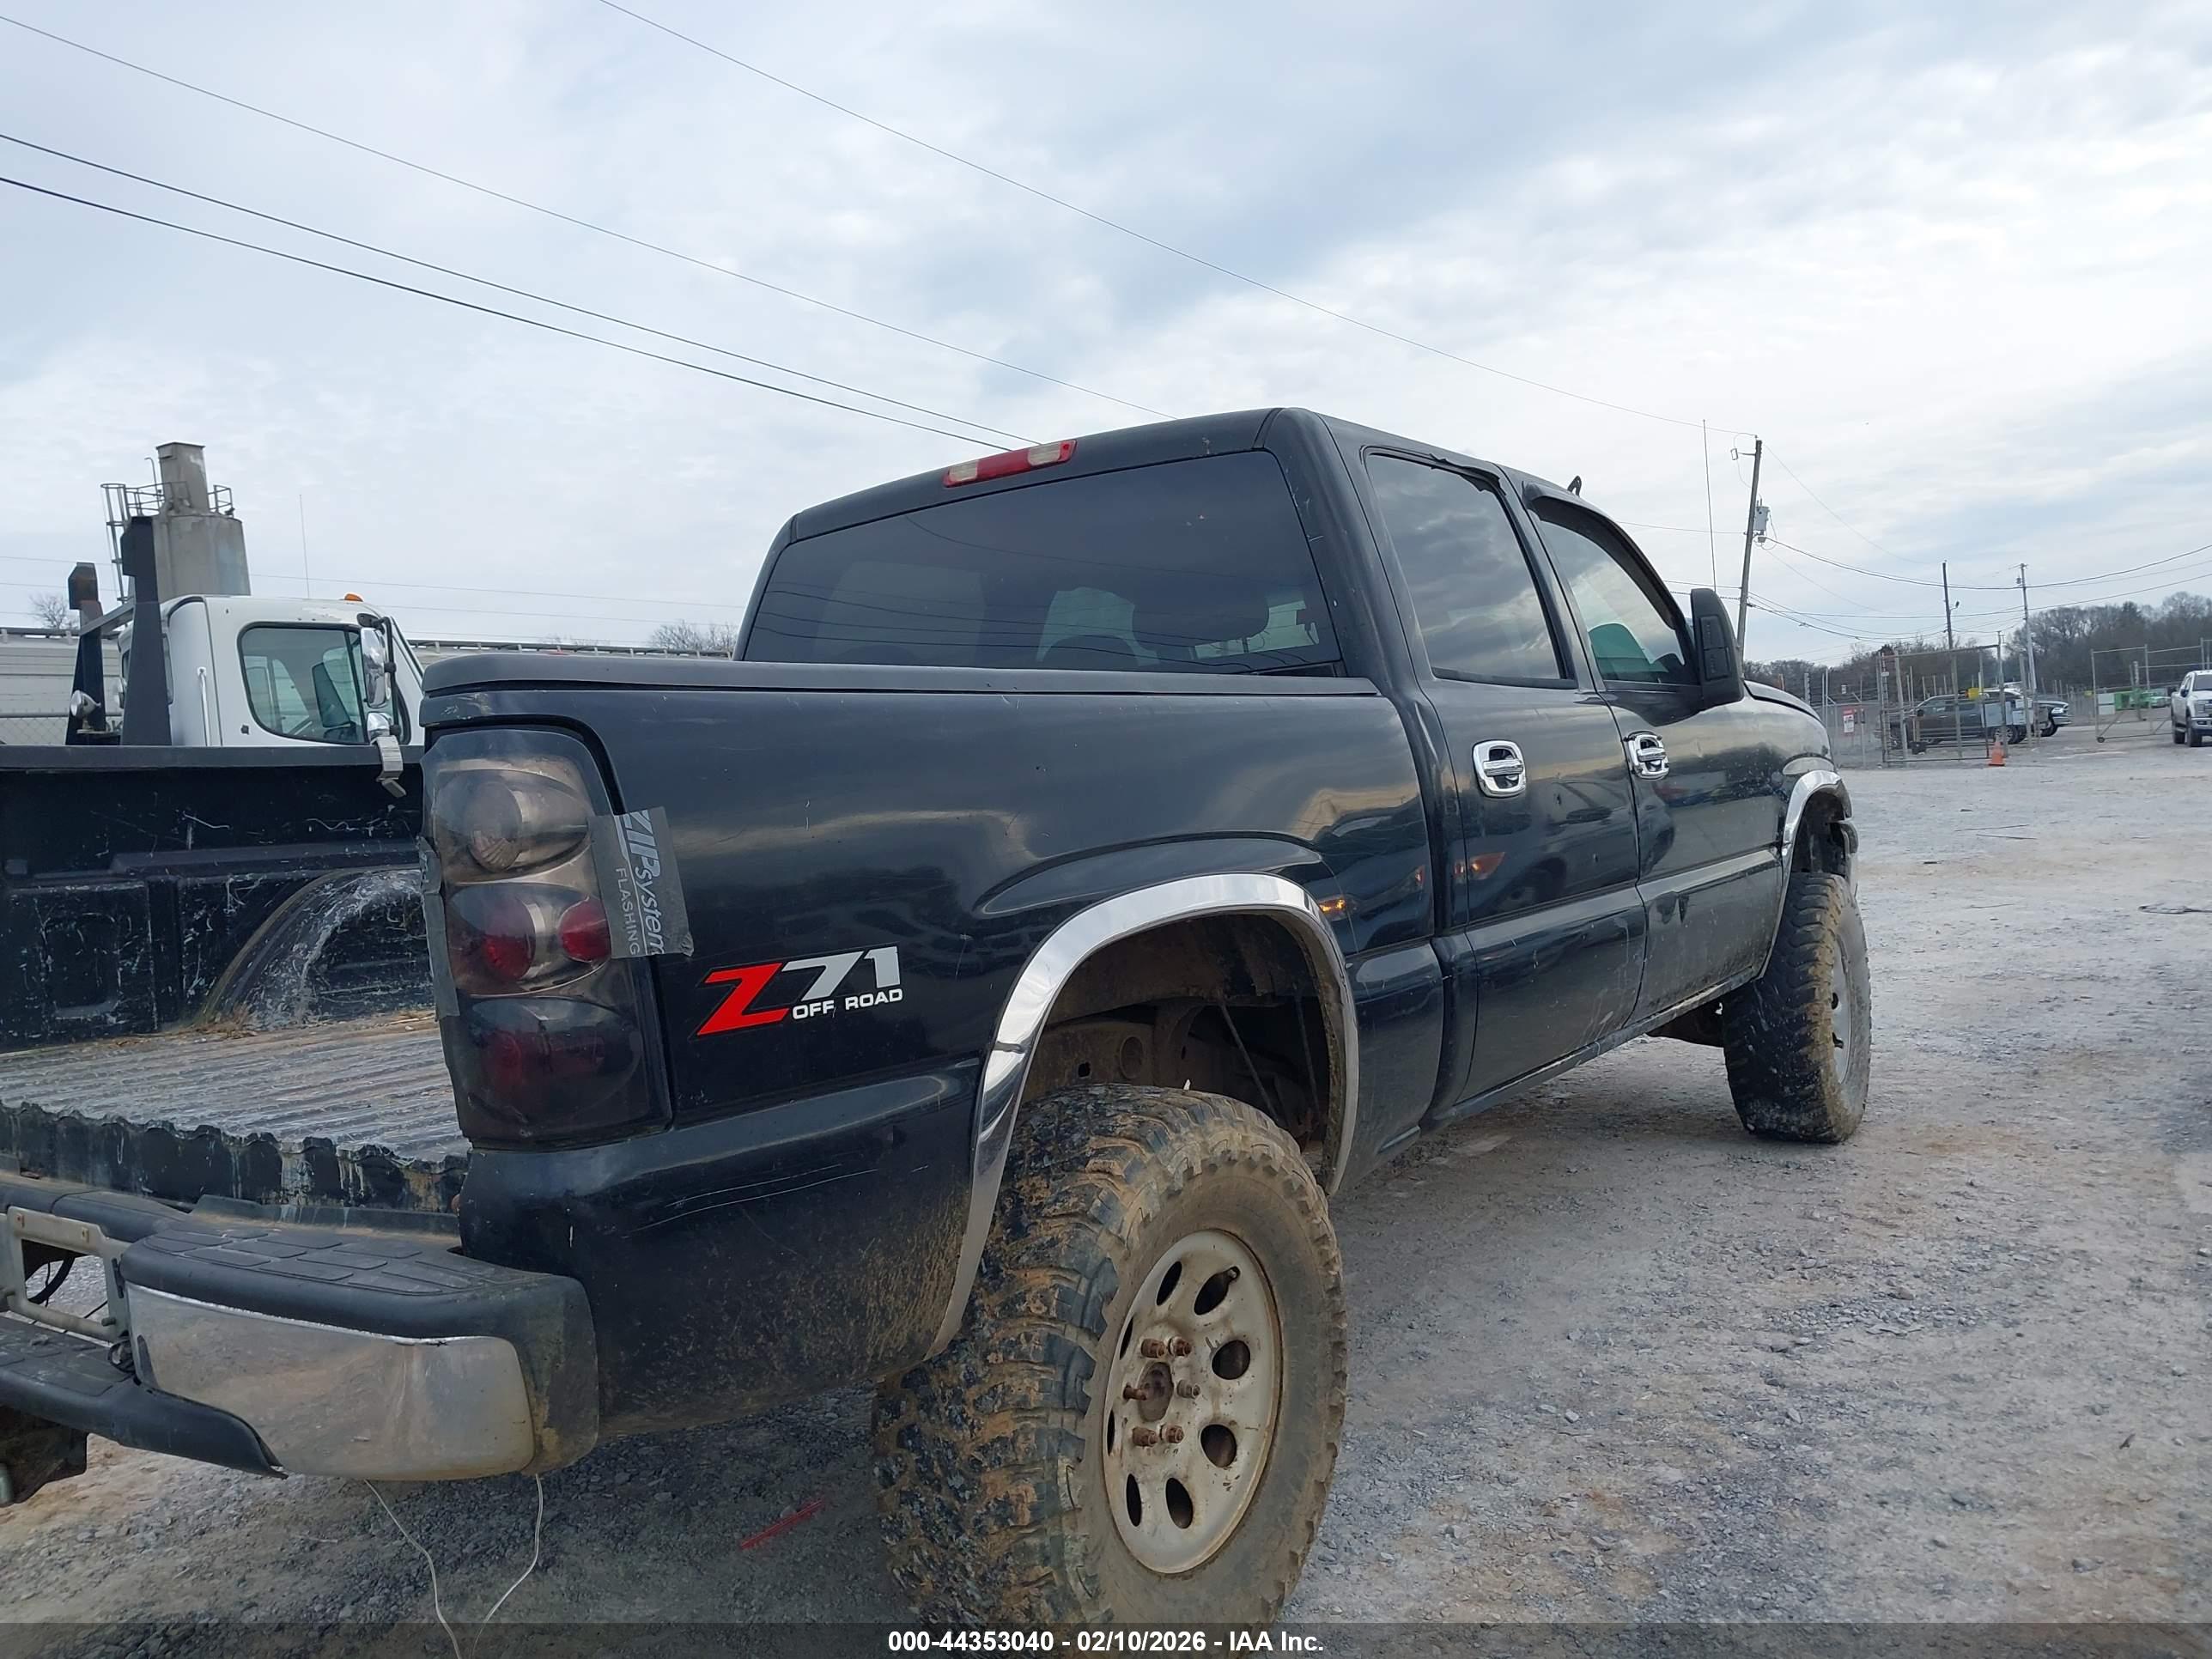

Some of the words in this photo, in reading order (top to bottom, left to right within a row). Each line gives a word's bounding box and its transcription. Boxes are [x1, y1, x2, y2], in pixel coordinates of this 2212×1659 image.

[615, 867, 641, 955] FLASHING
[696, 945, 901, 1036] Z71
[792, 1000, 836, 1020] OFF
[845, 988, 903, 1011] ROAD
